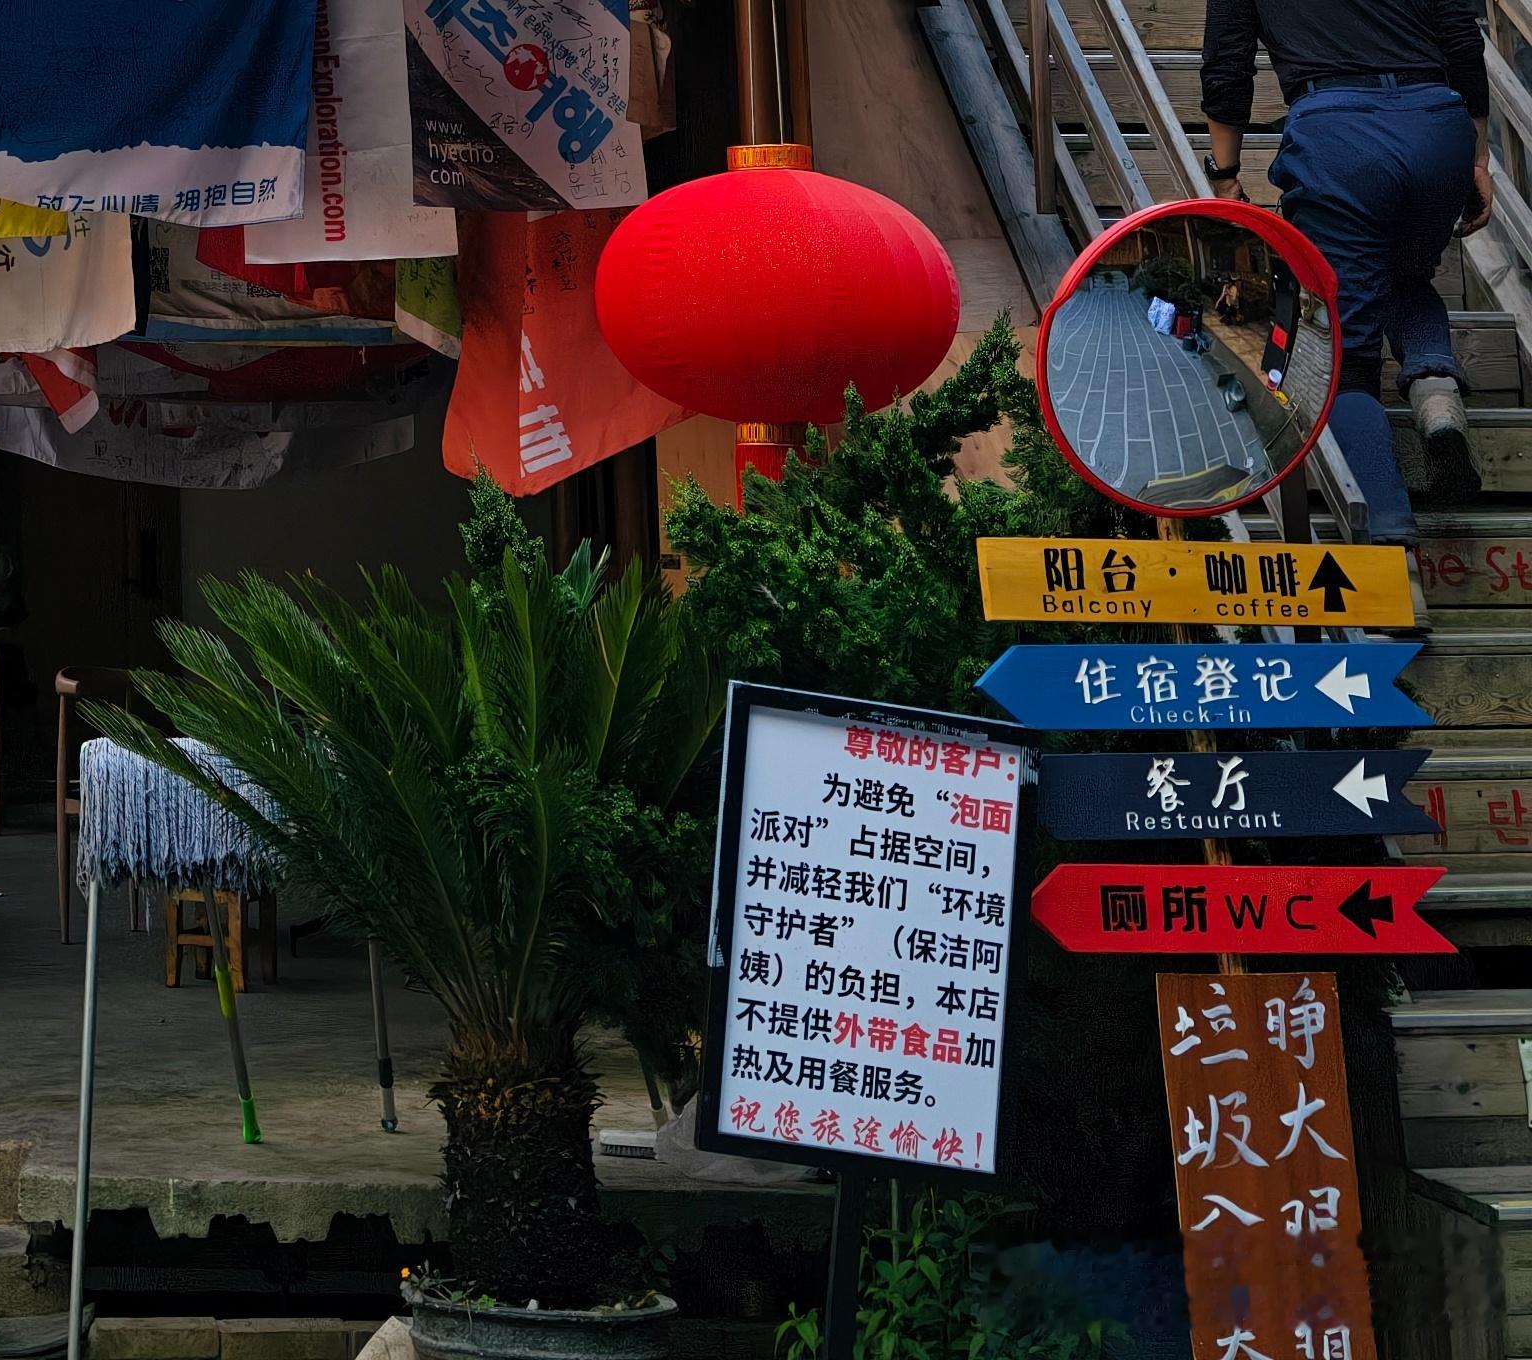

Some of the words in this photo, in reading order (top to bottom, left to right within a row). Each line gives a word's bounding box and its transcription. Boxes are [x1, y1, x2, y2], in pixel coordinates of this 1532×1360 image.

[424, 118, 466, 137] www.
[430, 167, 465, 186] com
[174, 176, 278, 212] 拥抱自然
[1042, 593, 1153, 618] Balcony
[1216, 599, 1310, 618] coffee
[1075, 655, 1299, 705] 住宿登记
[1130, 704, 1252, 724] Check-in
[1145, 755, 1251, 813] 餐厅
[1125, 810, 1283, 830] Restaurant
[1100, 884, 1208, 934] 厕所
[735, 997, 996, 1070] 不提供外带食品加
